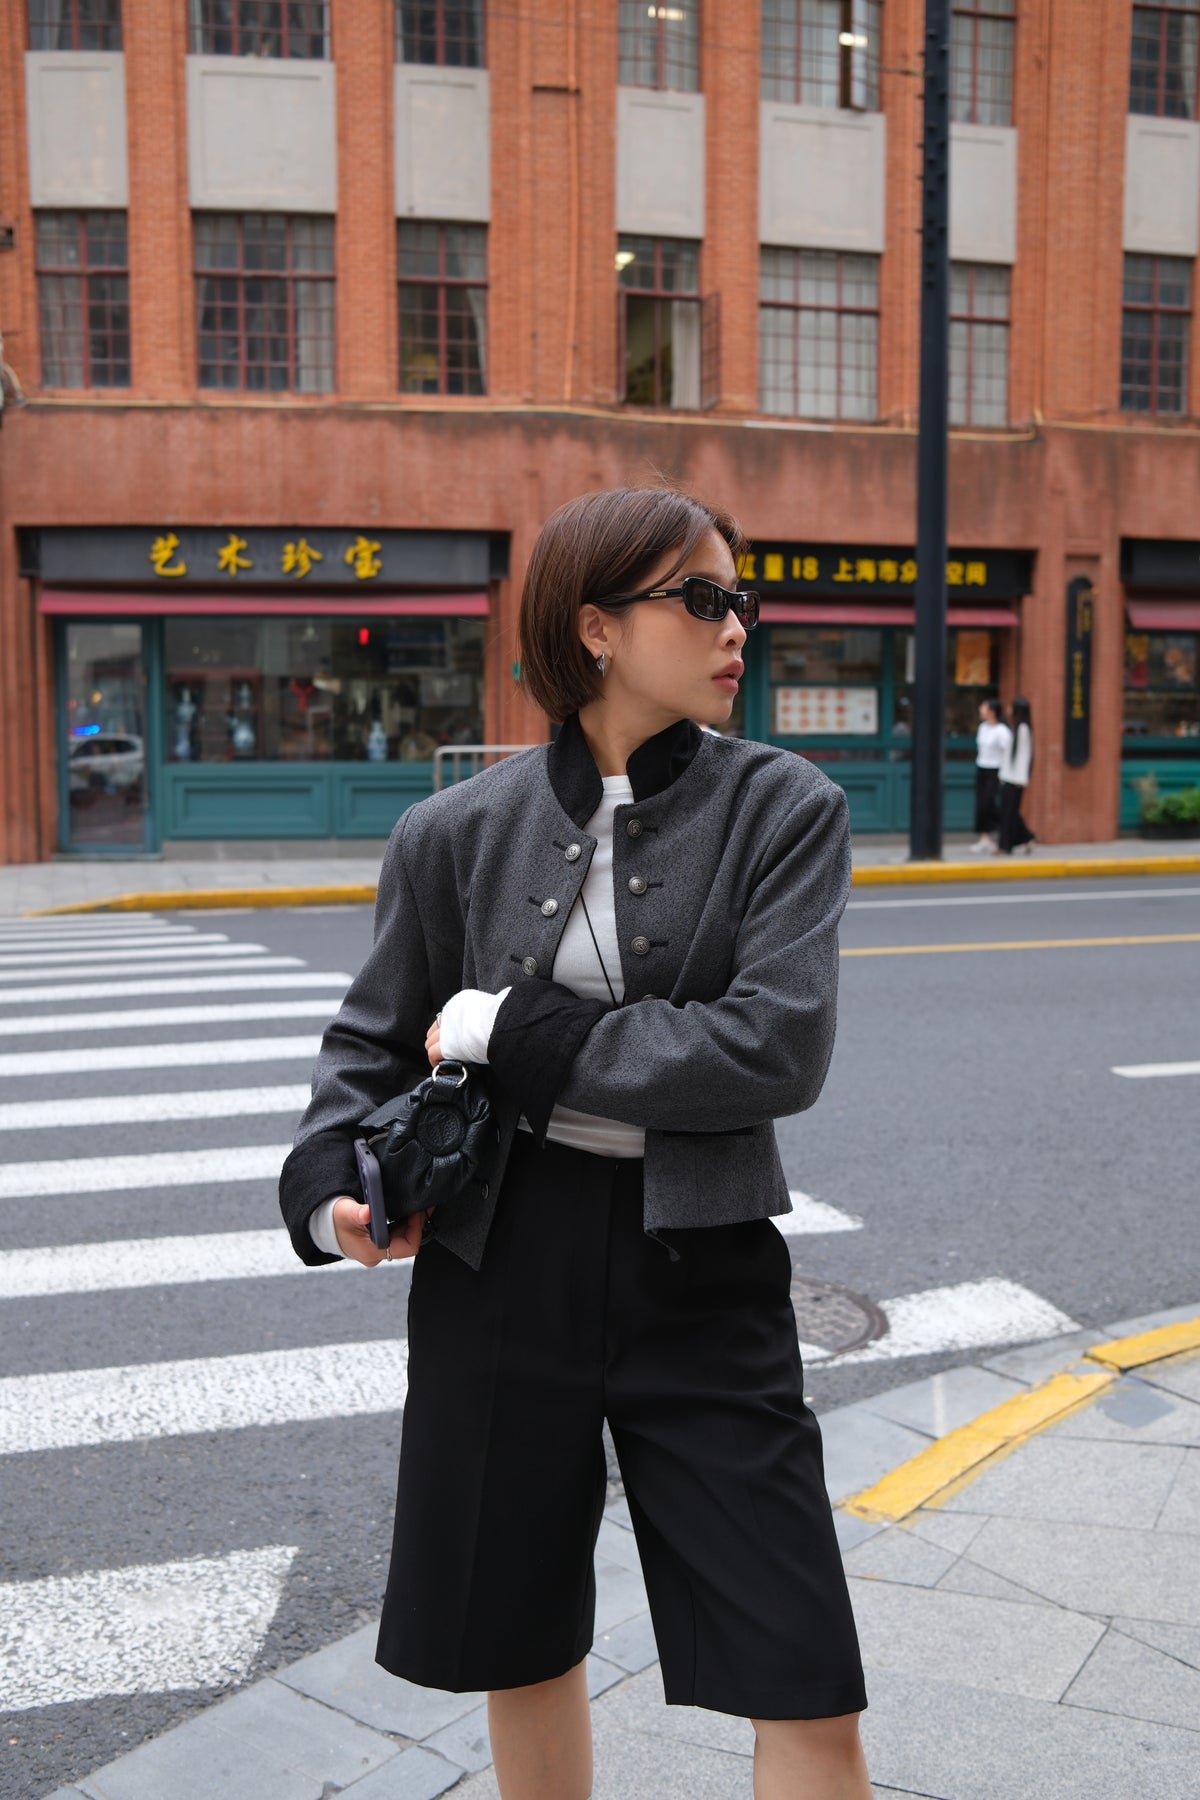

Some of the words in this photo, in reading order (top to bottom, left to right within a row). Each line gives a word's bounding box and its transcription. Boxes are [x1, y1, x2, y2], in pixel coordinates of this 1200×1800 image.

[150, 532, 382, 580] 艺术珍宝
[832, 557, 987, 586] 上海市众空间
